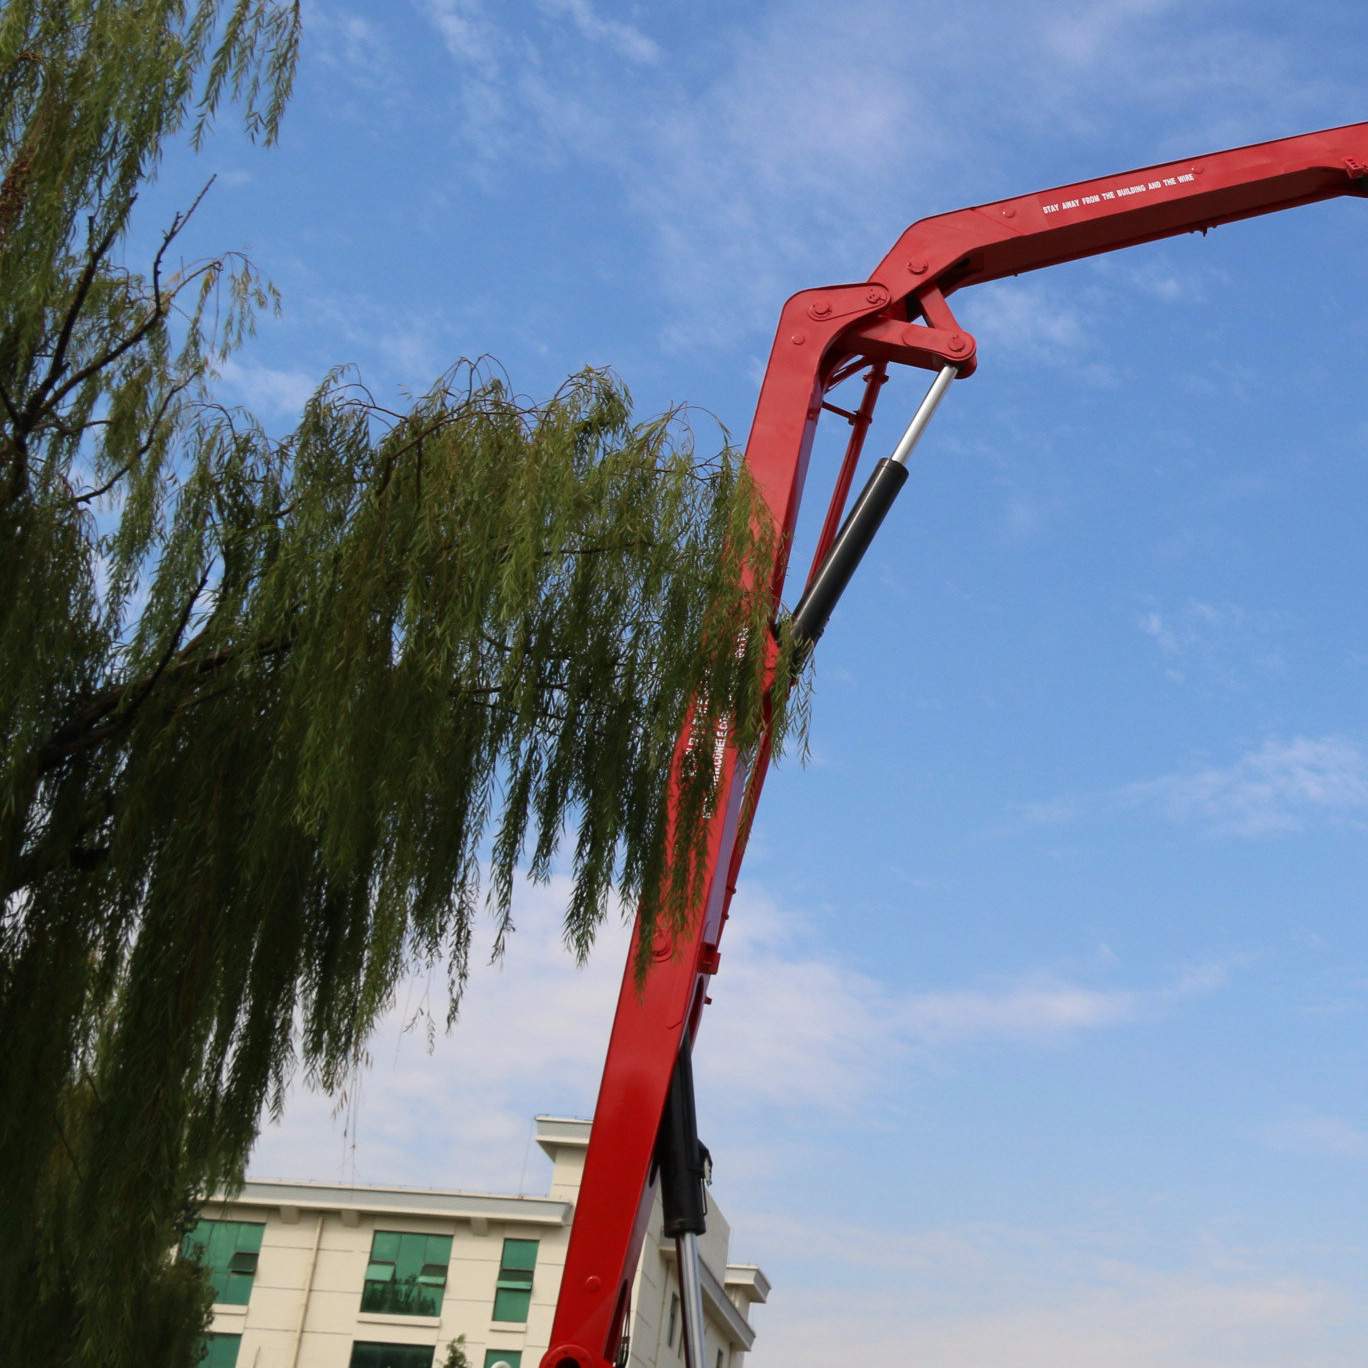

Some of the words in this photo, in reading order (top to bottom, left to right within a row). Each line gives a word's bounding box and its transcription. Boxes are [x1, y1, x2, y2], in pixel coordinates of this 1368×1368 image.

[1042, 203, 1060, 214] STAY
[1061, 198, 1080, 210] AWAY
[1081, 194, 1101, 206] FROM
[1101, 190, 1116, 201] THE
[1116, 184, 1147, 198] BUILDING
[1147, 180, 1162, 191] AND
[1162, 177, 1177, 187] THE
[1176, 173, 1195, 184] WIRE
